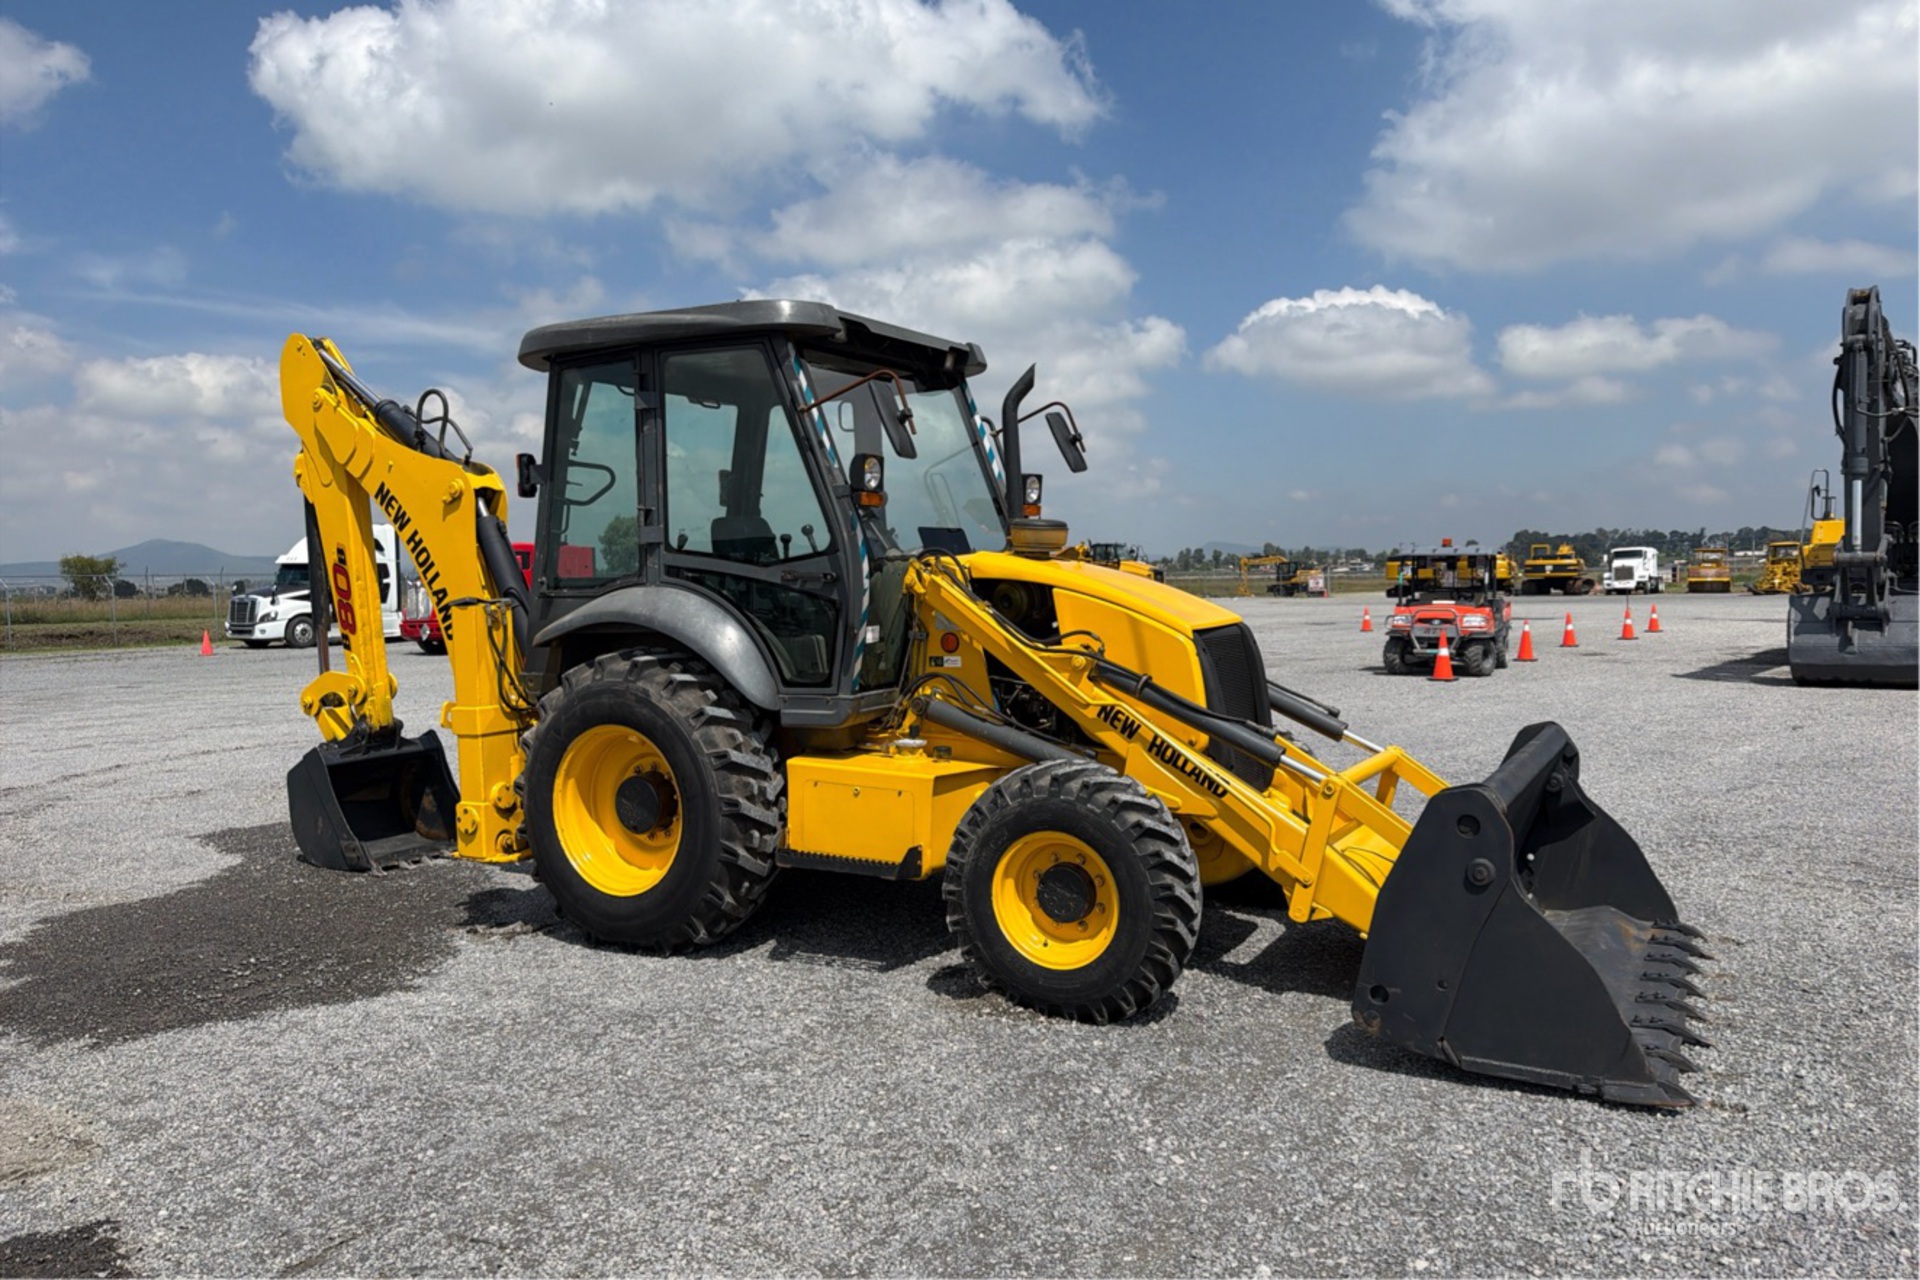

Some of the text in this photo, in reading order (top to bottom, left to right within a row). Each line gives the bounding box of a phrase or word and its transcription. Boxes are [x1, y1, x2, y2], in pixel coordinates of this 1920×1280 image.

[374, 481, 411, 532] NEW
[1096, 705, 1231, 798] NEW HOLLAND
